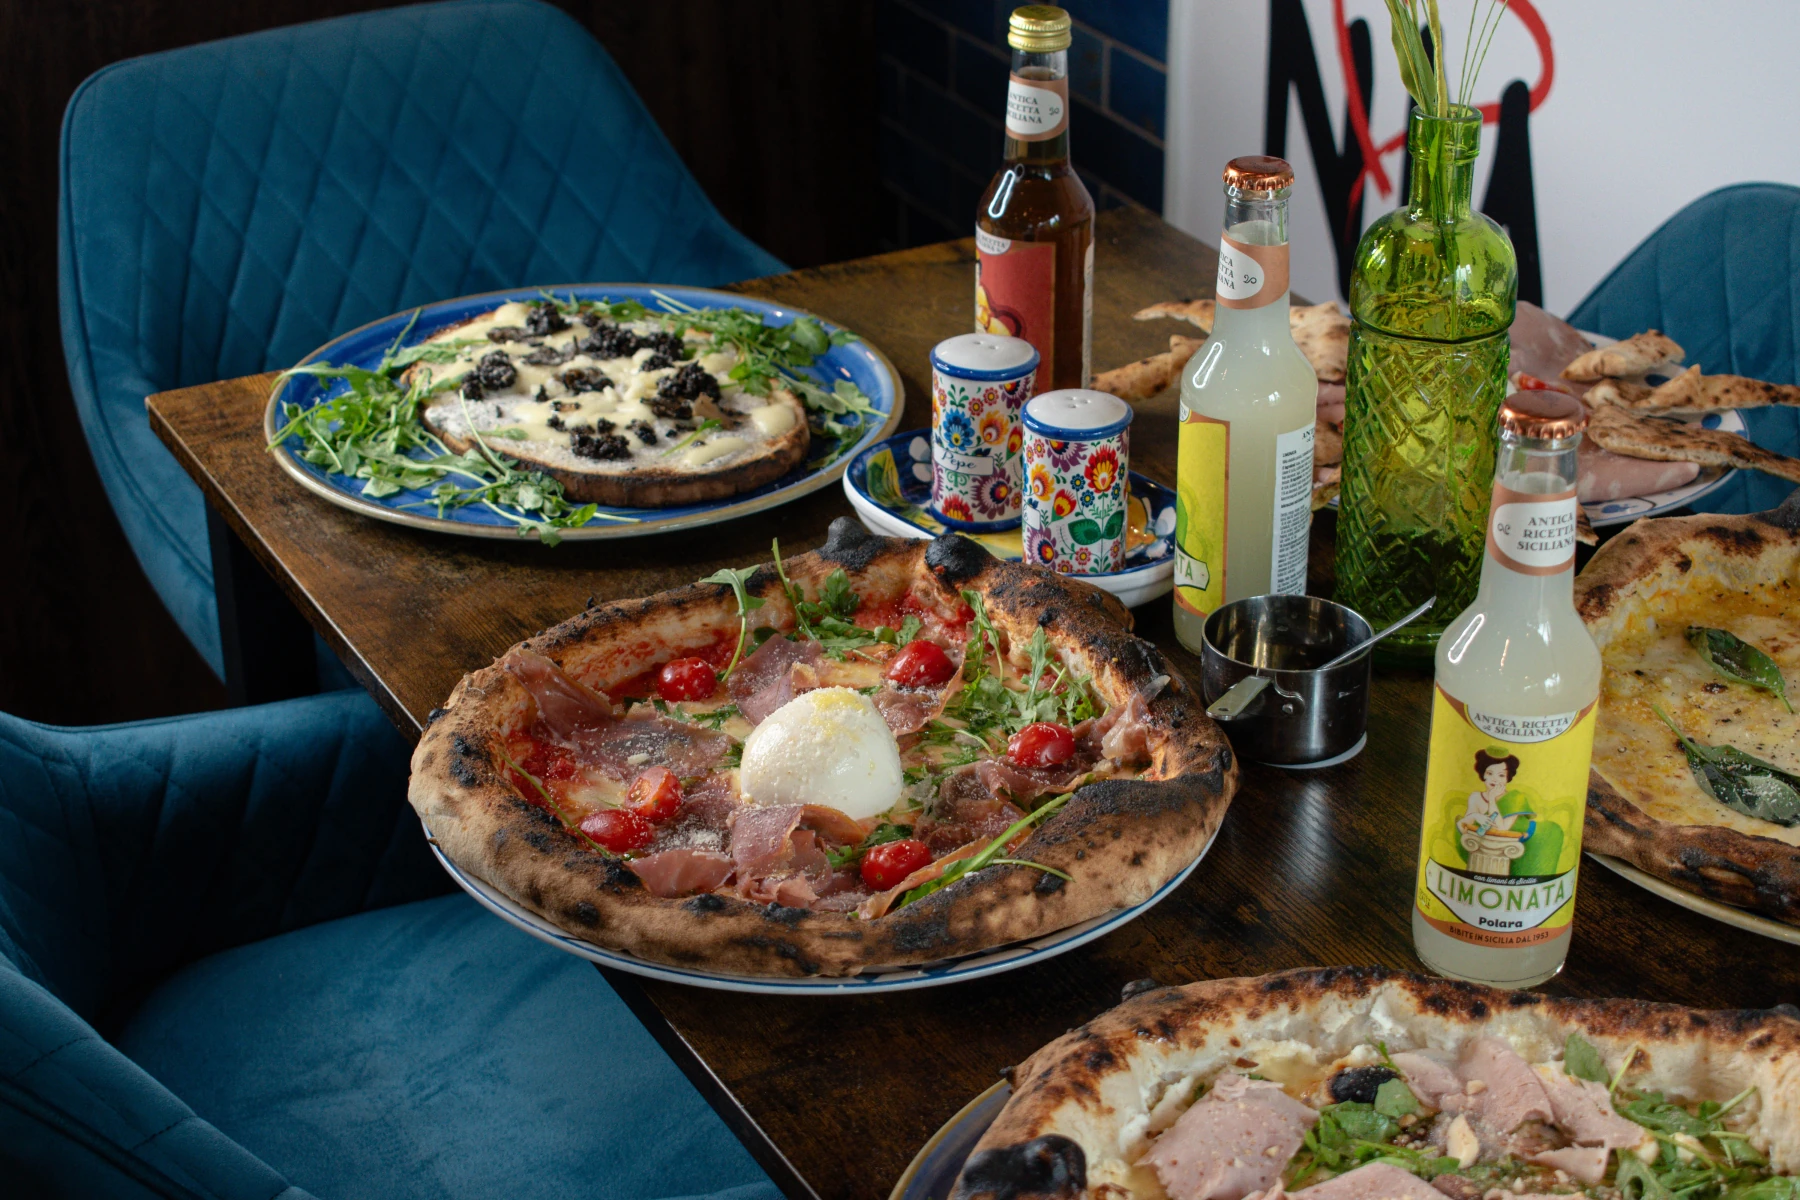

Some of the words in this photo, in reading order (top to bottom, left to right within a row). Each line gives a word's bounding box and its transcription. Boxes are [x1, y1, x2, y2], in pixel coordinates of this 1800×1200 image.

[942, 451, 976, 470] Pepe
[1528, 512, 1573, 526] ANTICA
[1523, 524, 1574, 538] RICETTA
[1474, 713, 1516, 728] ANTICA
[1522, 718, 1569, 728] RICETTA
[1494, 726, 1551, 737] SICILIANA
[1438, 871, 1565, 911] LIMONATA
[1479, 917, 1523, 928] Polara
[1450, 926, 1473, 939] BIBITE
[1474, 933, 1483, 941] IN
[1484, 935, 1514, 944] SICILIA
[1516, 936, 1531, 944] DAL
[1533, 932, 1549, 941] 1953
